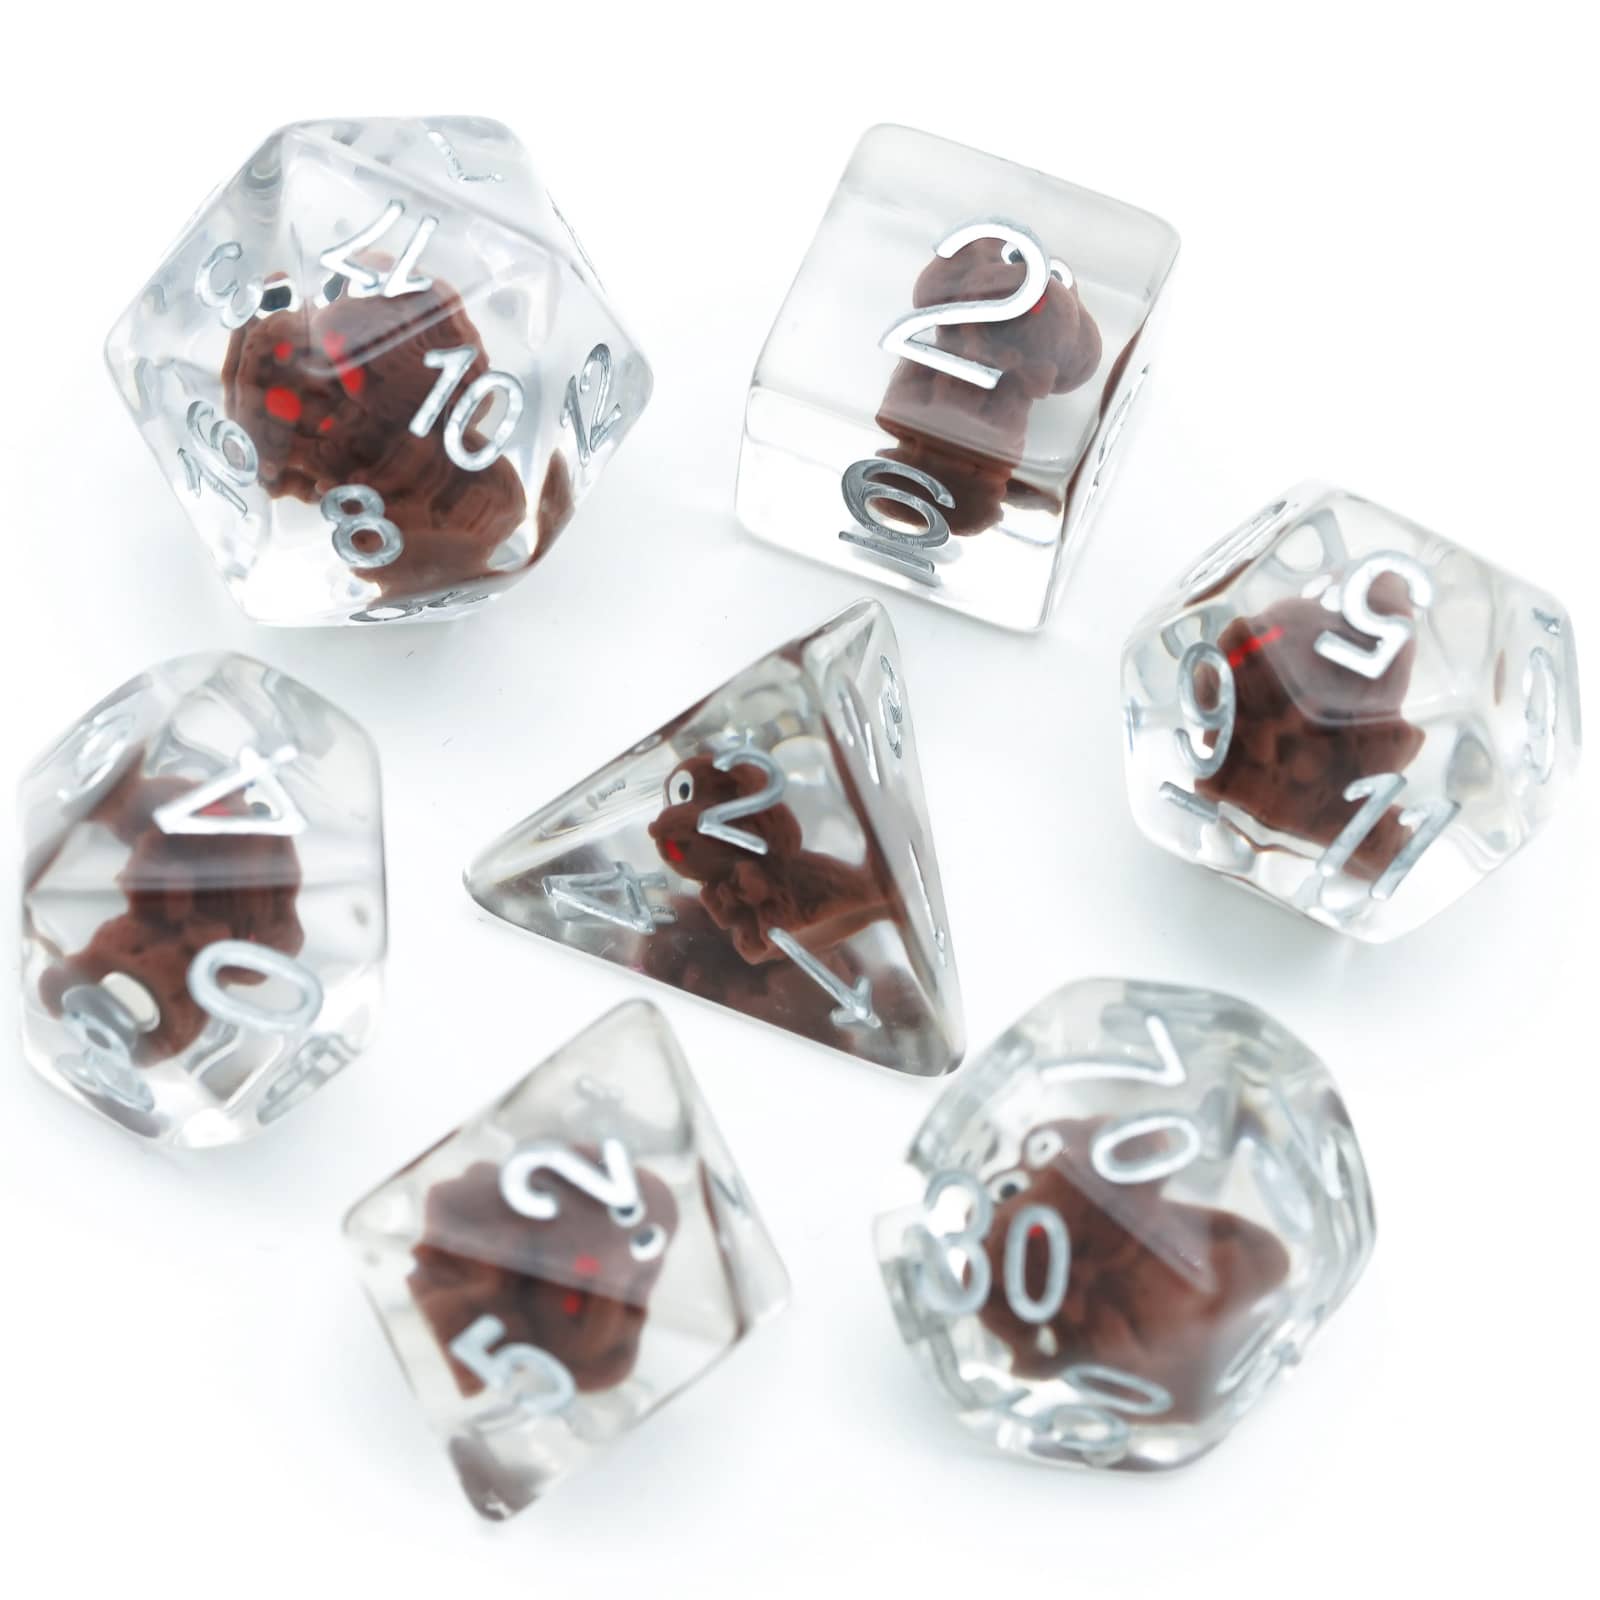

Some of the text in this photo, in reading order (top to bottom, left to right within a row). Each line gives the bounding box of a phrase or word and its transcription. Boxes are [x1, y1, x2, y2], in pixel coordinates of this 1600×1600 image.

[195, 241, 264, 329] 3
[319, 200, 440, 299] 17
[878, 214, 1052, 390] 2
[177, 400, 259, 517] 16
[408, 344, 526, 472] 10
[557, 342, 624, 467] 12
[319, 484, 405, 568] 8
[1313, 549, 1434, 680] 5
[1158, 641, 1239, 824] 9
[152, 744, 308, 836] 4
[698, 750, 786, 855] 2
[1315, 772, 1463, 901] 11
[186, 938, 325, 1032] 0
[501, 1136, 642, 1221] 2
[914, 1168, 1072, 1325] 30
[450, 1314, 578, 1418] 5
